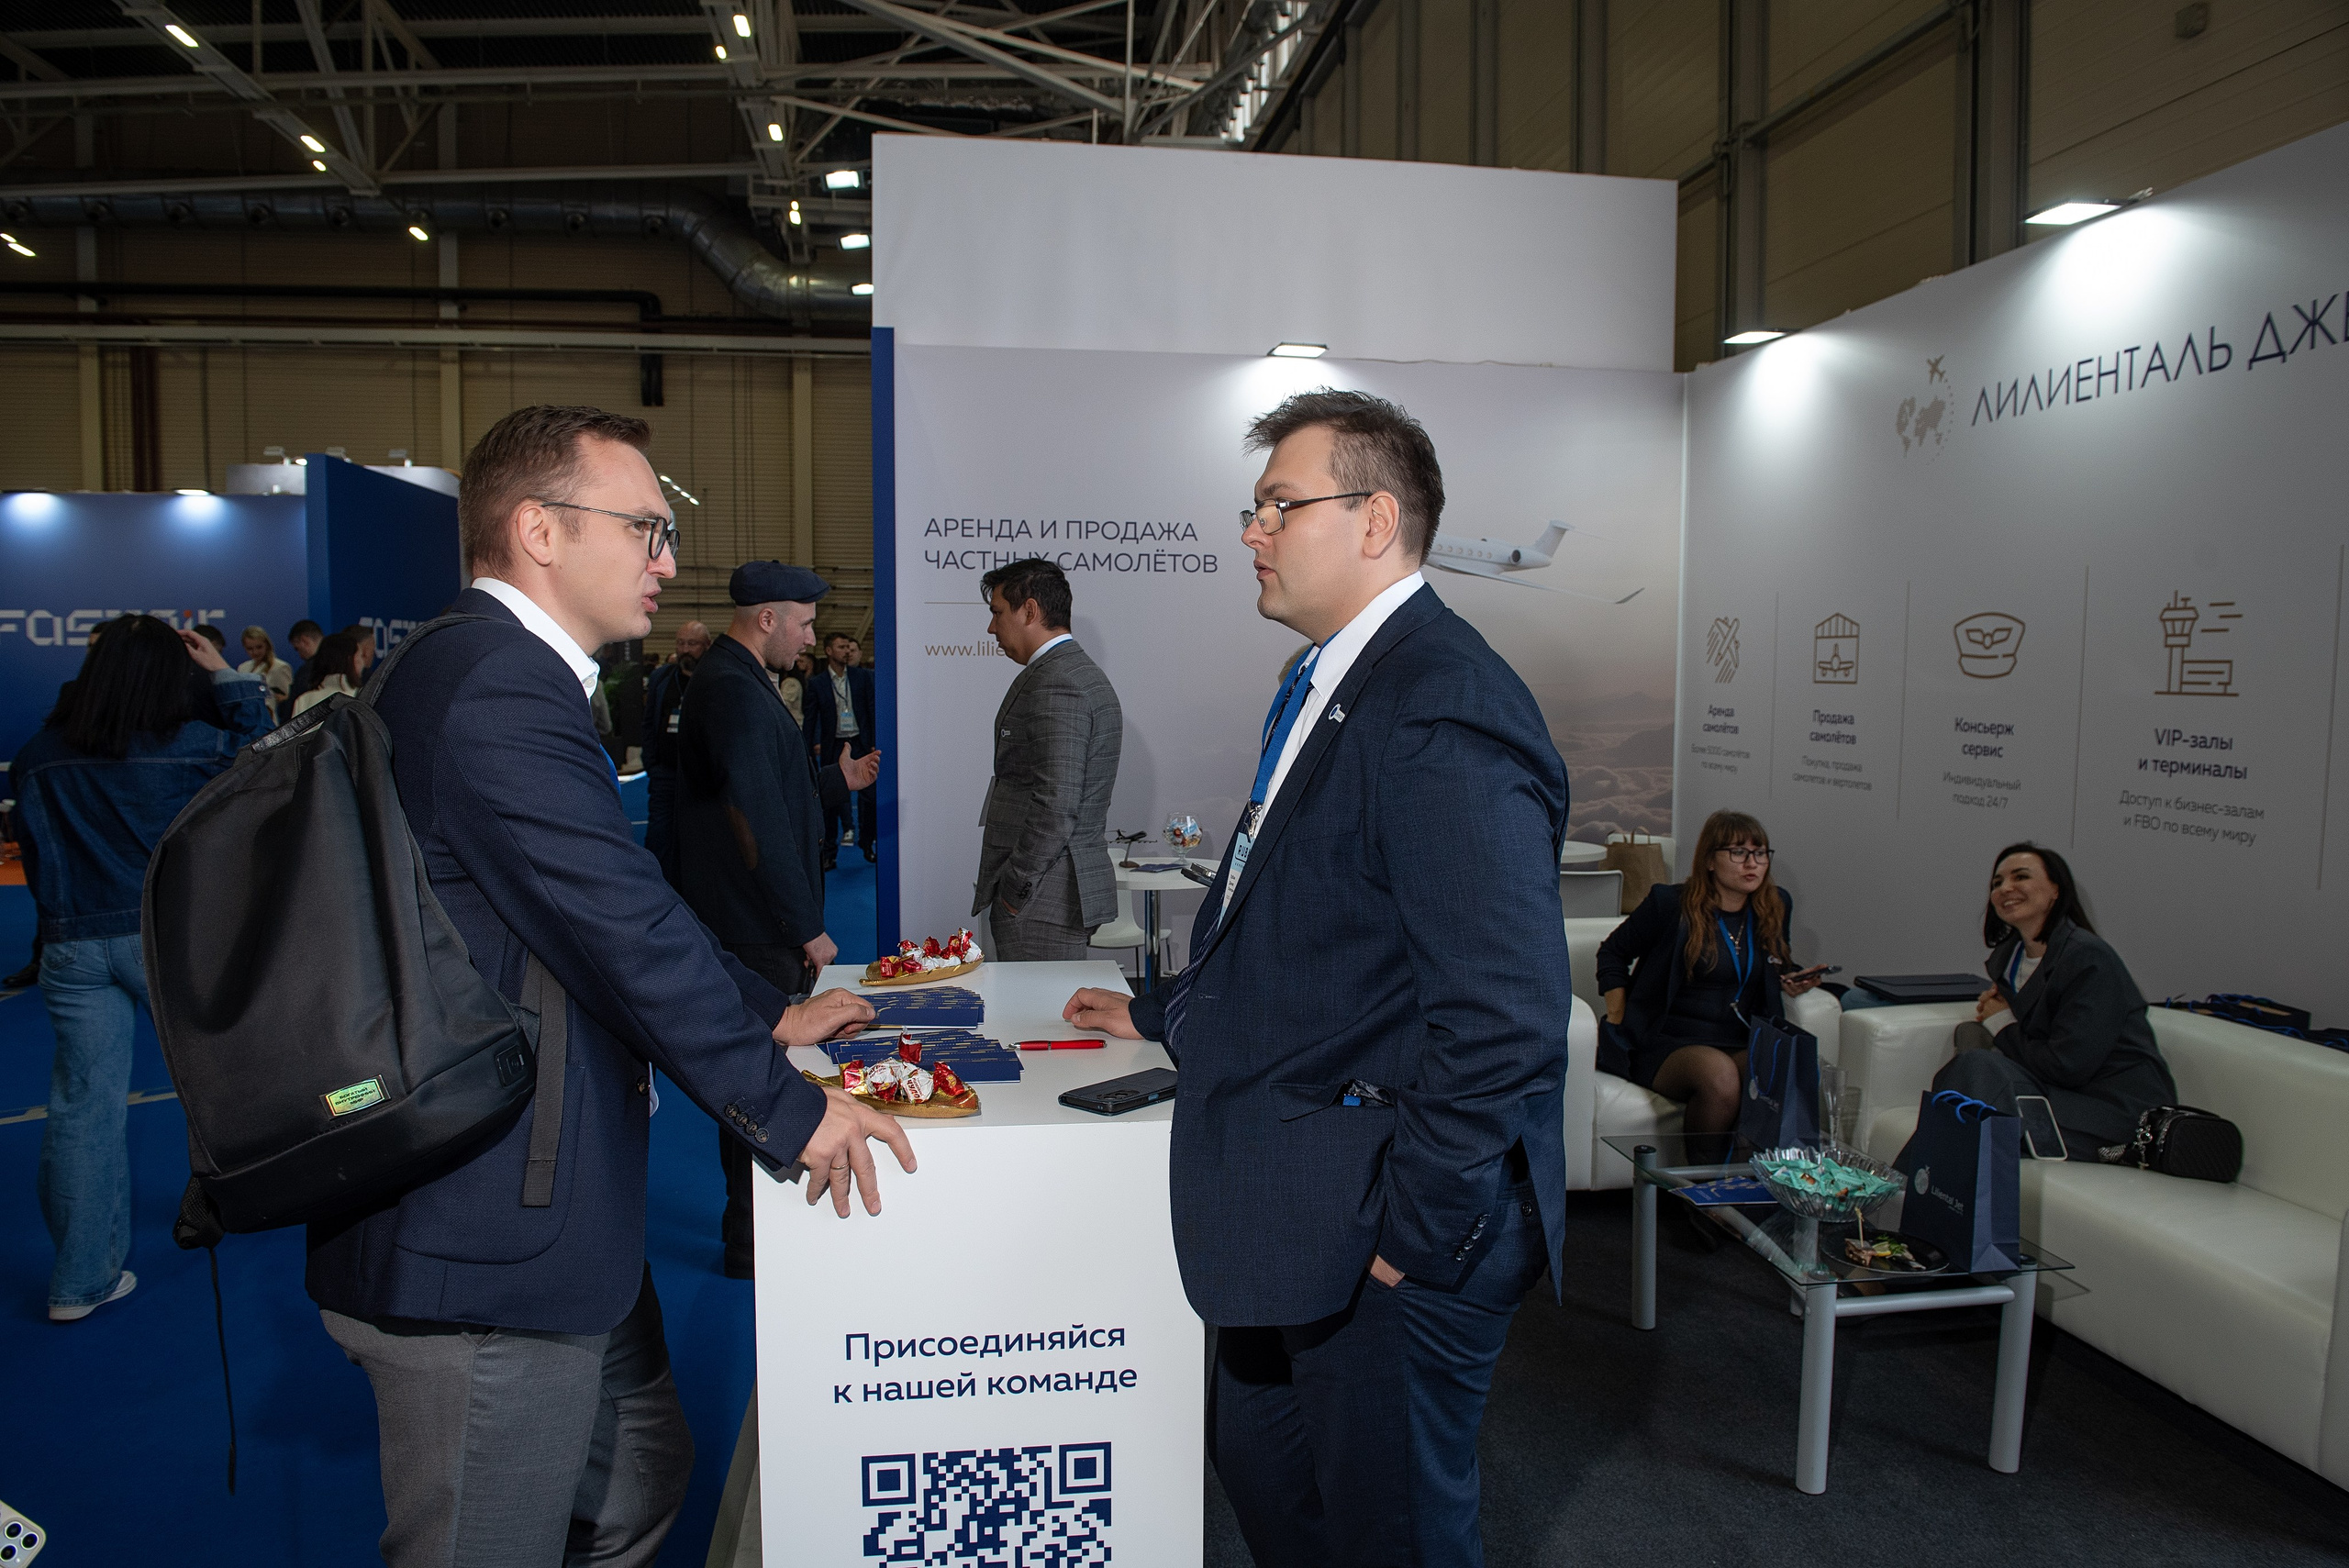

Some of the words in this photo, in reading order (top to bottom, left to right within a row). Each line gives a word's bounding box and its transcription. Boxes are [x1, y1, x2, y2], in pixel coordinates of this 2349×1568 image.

[1971, 325, 2233, 427] ЛИЛИЕНТАЛЬ
[2248, 290, 2349, 370] ДЖ
[924, 517, 1032, 542] АРЕНДА
[1041, 519, 1056, 539] И
[1066, 520, 1198, 544] ПРОДАЖА
[1057, 549, 1219, 573] САМОЛЁТОВ
[925, 640, 1006, 656] www.lilie
[1708, 705, 1734, 718] Аренда
[1812, 709, 1854, 726] Продажа
[1954, 717, 2014, 738] Консьерж
[2154, 728, 2233, 750] VIP-залы
[1962, 744, 2003, 759] сервис
[2138, 759, 2148, 770] и
[2152, 759, 2248, 779] терминалы
[1943, 772, 2021, 791] Индивидуальный
[1953, 794, 1985, 807] подход
[1987, 795, 2009, 808] 24/7
[2120, 790, 2162, 810] Доступ
[2165, 799, 2172, 807] к
[2174, 796, 2265, 819] бизнес-залам
[2123, 817, 2132, 826] и
[2133, 814, 2161, 830] FBO
[2163, 821, 2179, 833] по
[2181, 823, 2219, 842] всему
[2221, 829, 2257, 847] миру
[845, 1323, 1125, 1367] Присоединяйся
[833, 1385, 852, 1404] к
[863, 1372, 975, 1402] нашей
[987, 1369, 1137, 1396] команде
